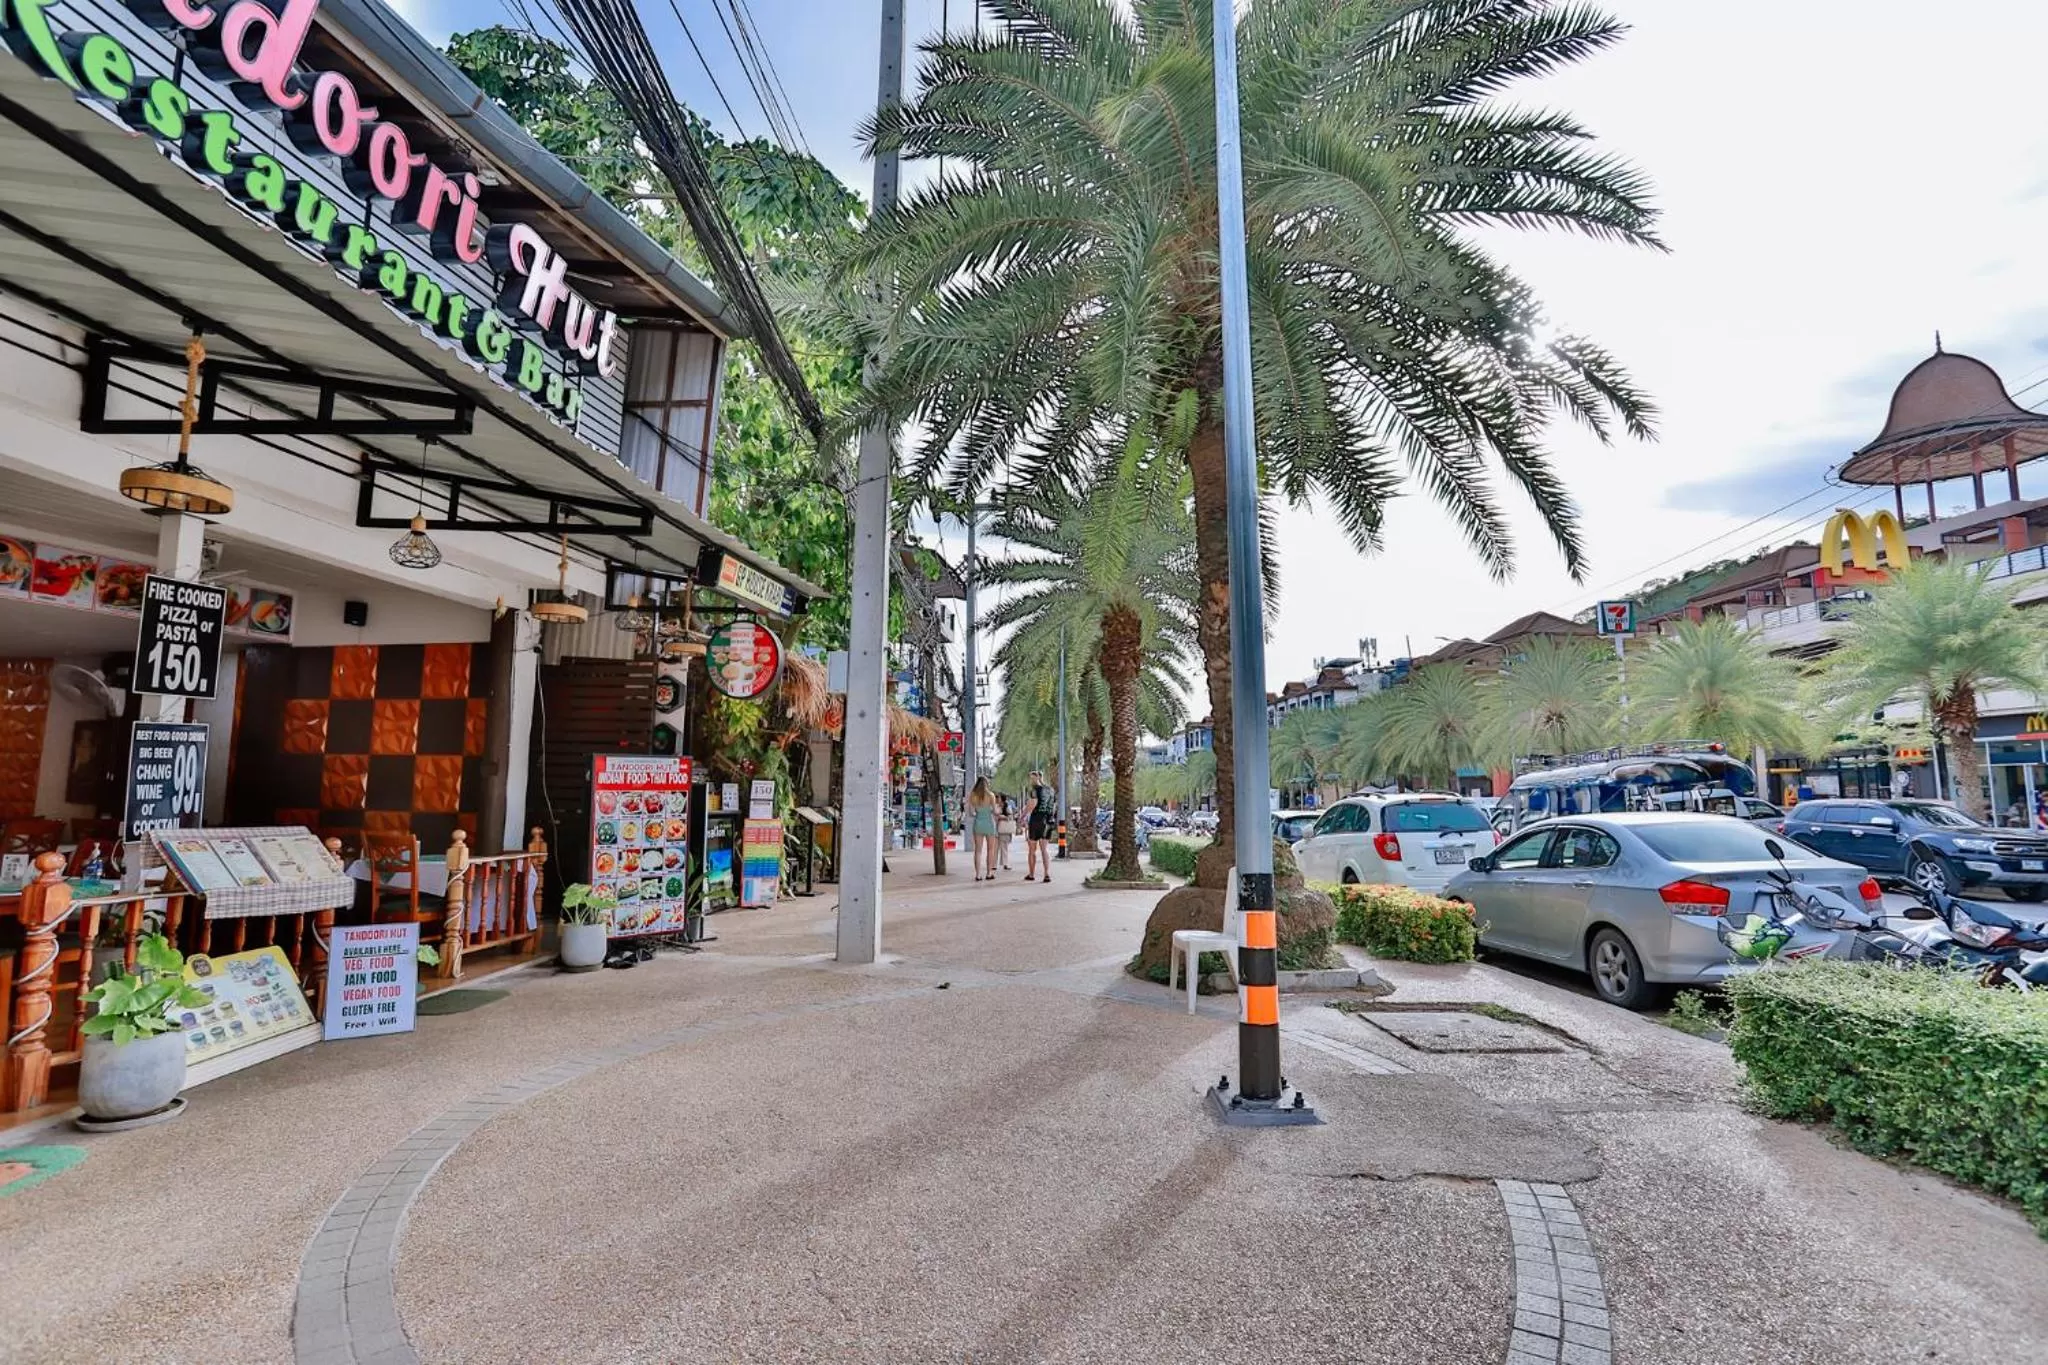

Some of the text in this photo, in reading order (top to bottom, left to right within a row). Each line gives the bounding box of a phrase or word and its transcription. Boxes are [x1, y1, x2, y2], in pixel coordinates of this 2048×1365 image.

[160, 0, 618, 378] doori Hut
[517, 339, 584, 420] Bar
[148, 581, 222, 609] FIRE COOKED
[159, 604, 198, 625] PIZZA
[156, 623, 197, 643] PASTA
[200, 621, 214, 633] or
[148, 641, 208, 692] 150.
[136, 730, 153, 741] BEST
[154, 731, 171, 741] FOOD
[171, 731, 188, 741] GOOD
[139, 747, 173, 758] BIG BEER
[136, 763, 172, 780] CHANG
[656, 763, 673, 771] HUT
[668, 773, 689, 784] FOOD
[136, 784, 163, 800] WINE
[141, 803, 155, 815] or
[344, 928, 407, 941] TANDOORI HUT
[343, 946, 382, 956] AVAILABLE
[344, 957, 394, 971] VEG. FOOD
[344, 970, 397, 986] JAIN FOOD
[343, 985, 401, 1001] VEGAN FOOD
[342, 1002, 396, 1017] GLUTEN FREE
[344, 1021, 367, 1030] Free
[379, 1016, 397, 1026] Wifi
